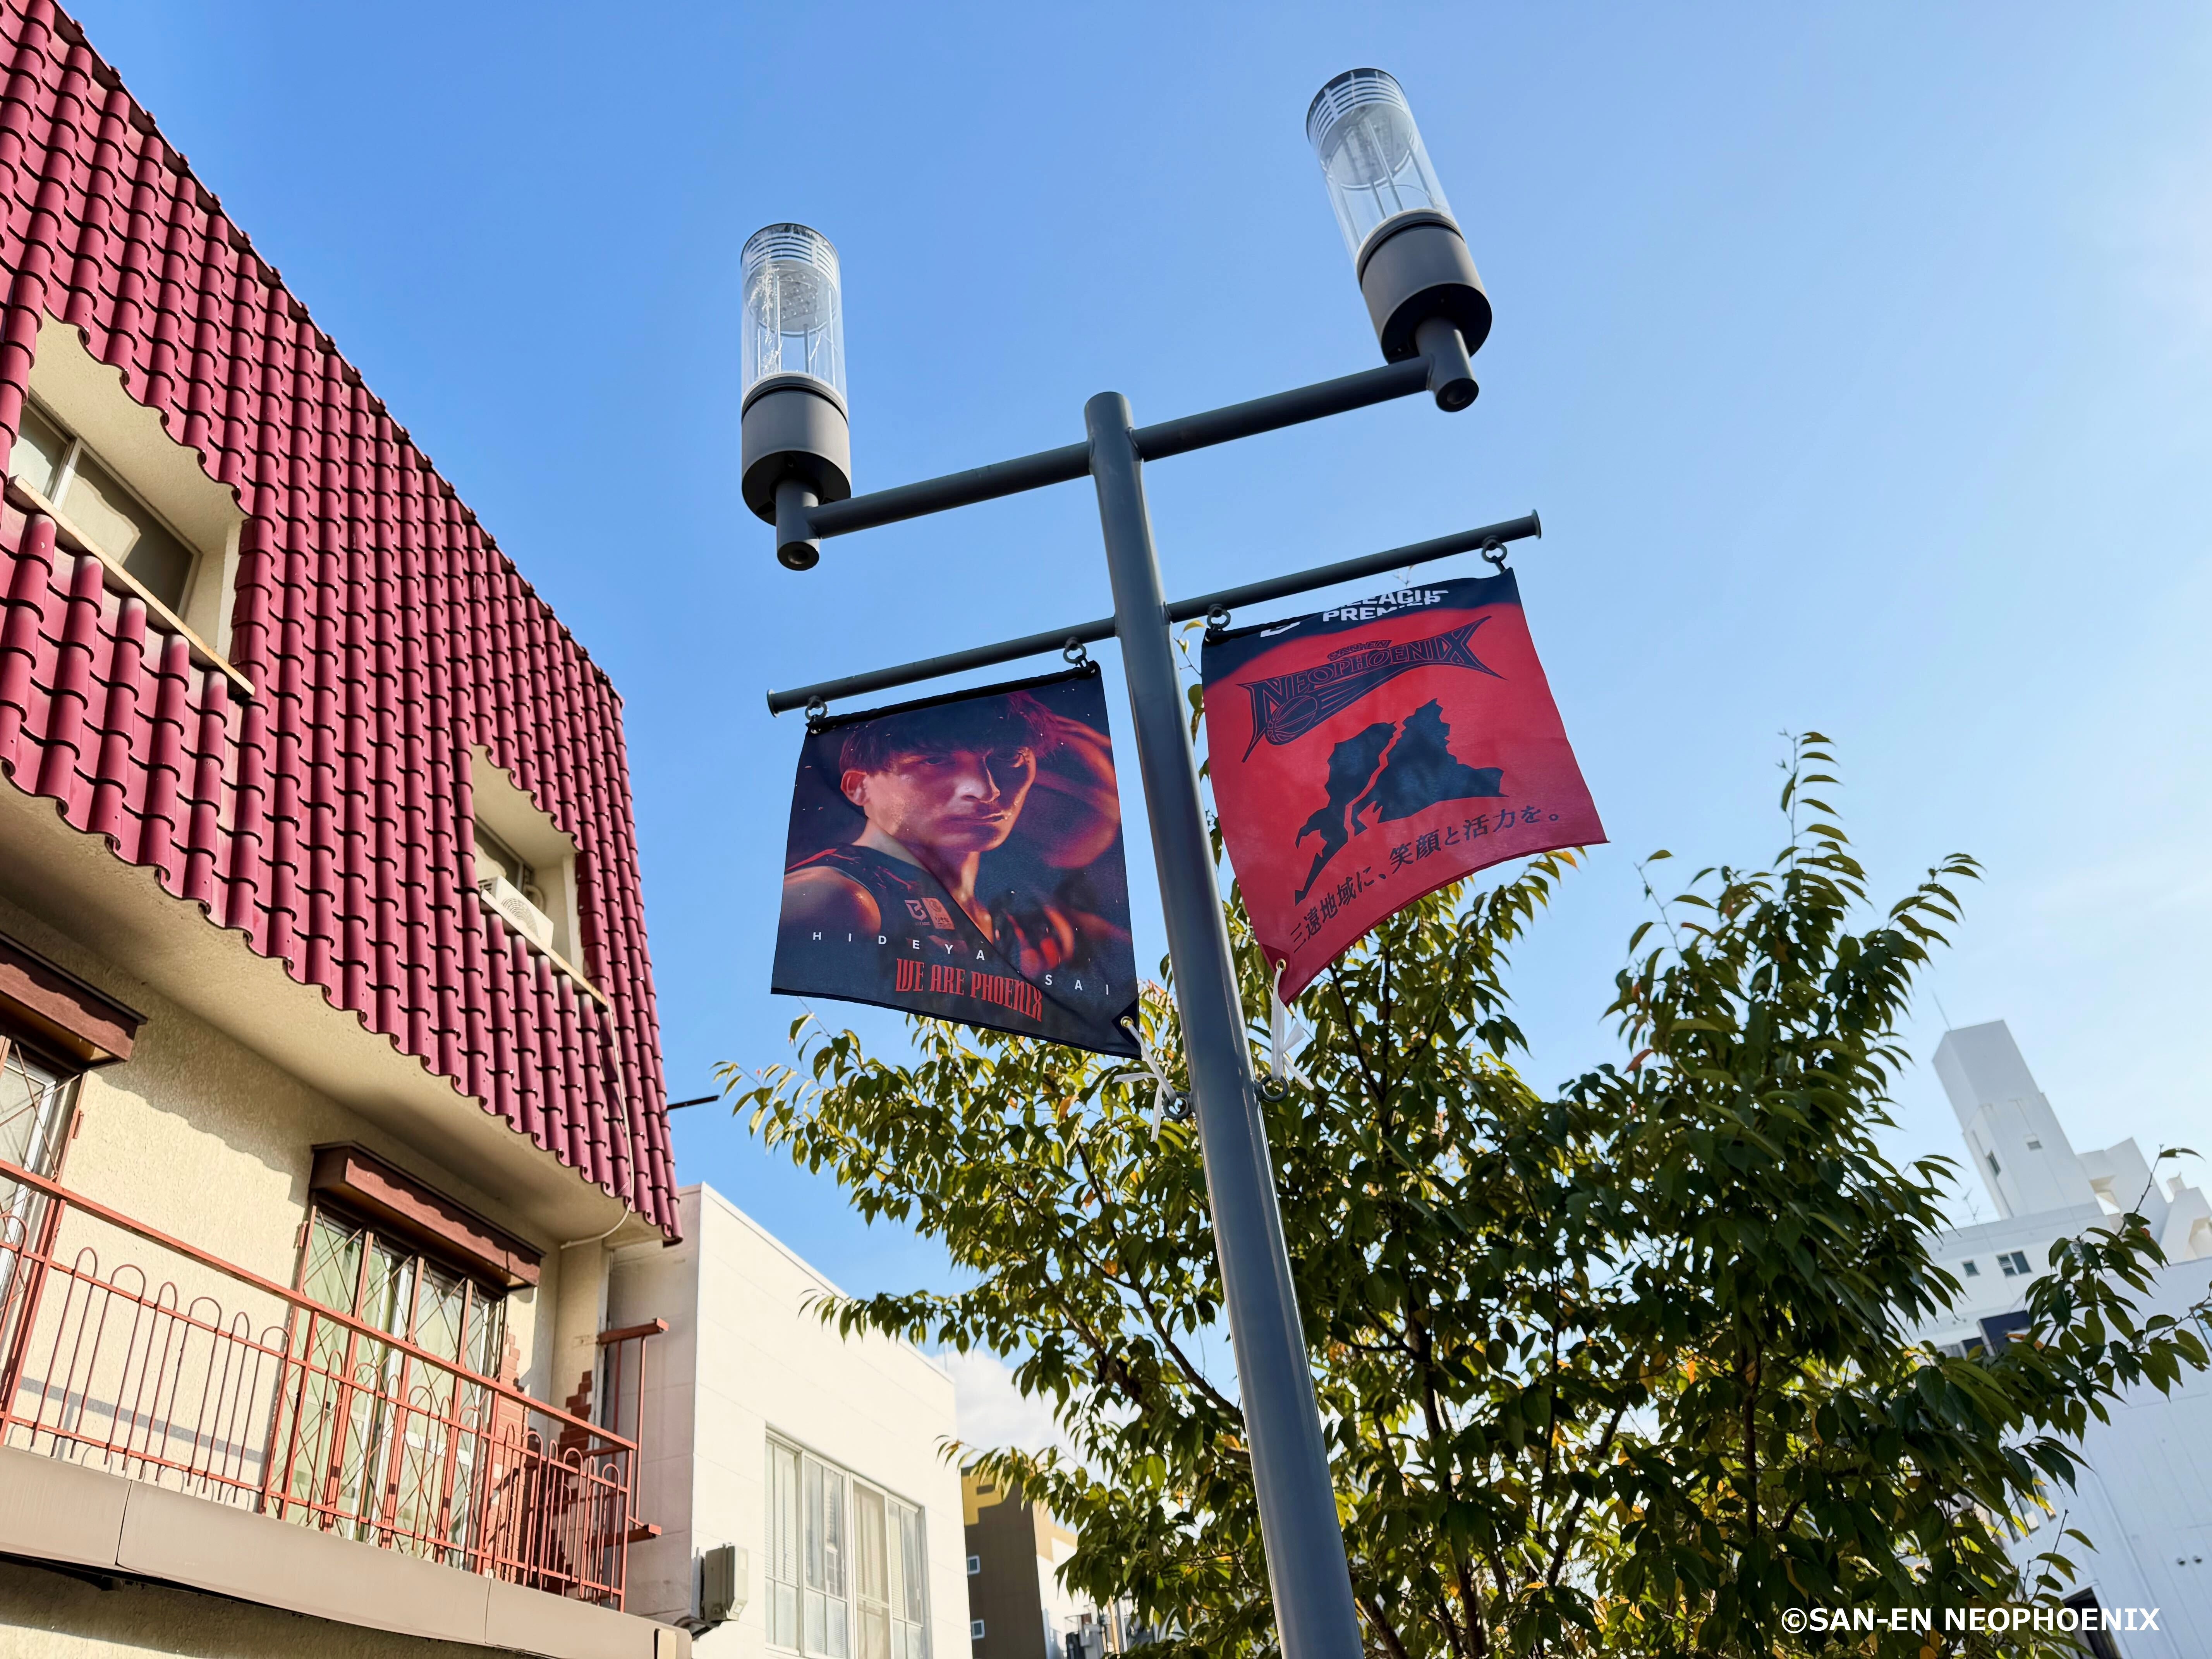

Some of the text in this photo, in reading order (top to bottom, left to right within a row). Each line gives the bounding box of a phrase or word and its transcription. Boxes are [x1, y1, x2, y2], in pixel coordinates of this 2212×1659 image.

[1236, 616, 1508, 763] NEOPHOENIX
[813, 932, 1109, 995] HIDEYA SAI
[895, 958, 1042, 1022] WE ARE PHOENIX
